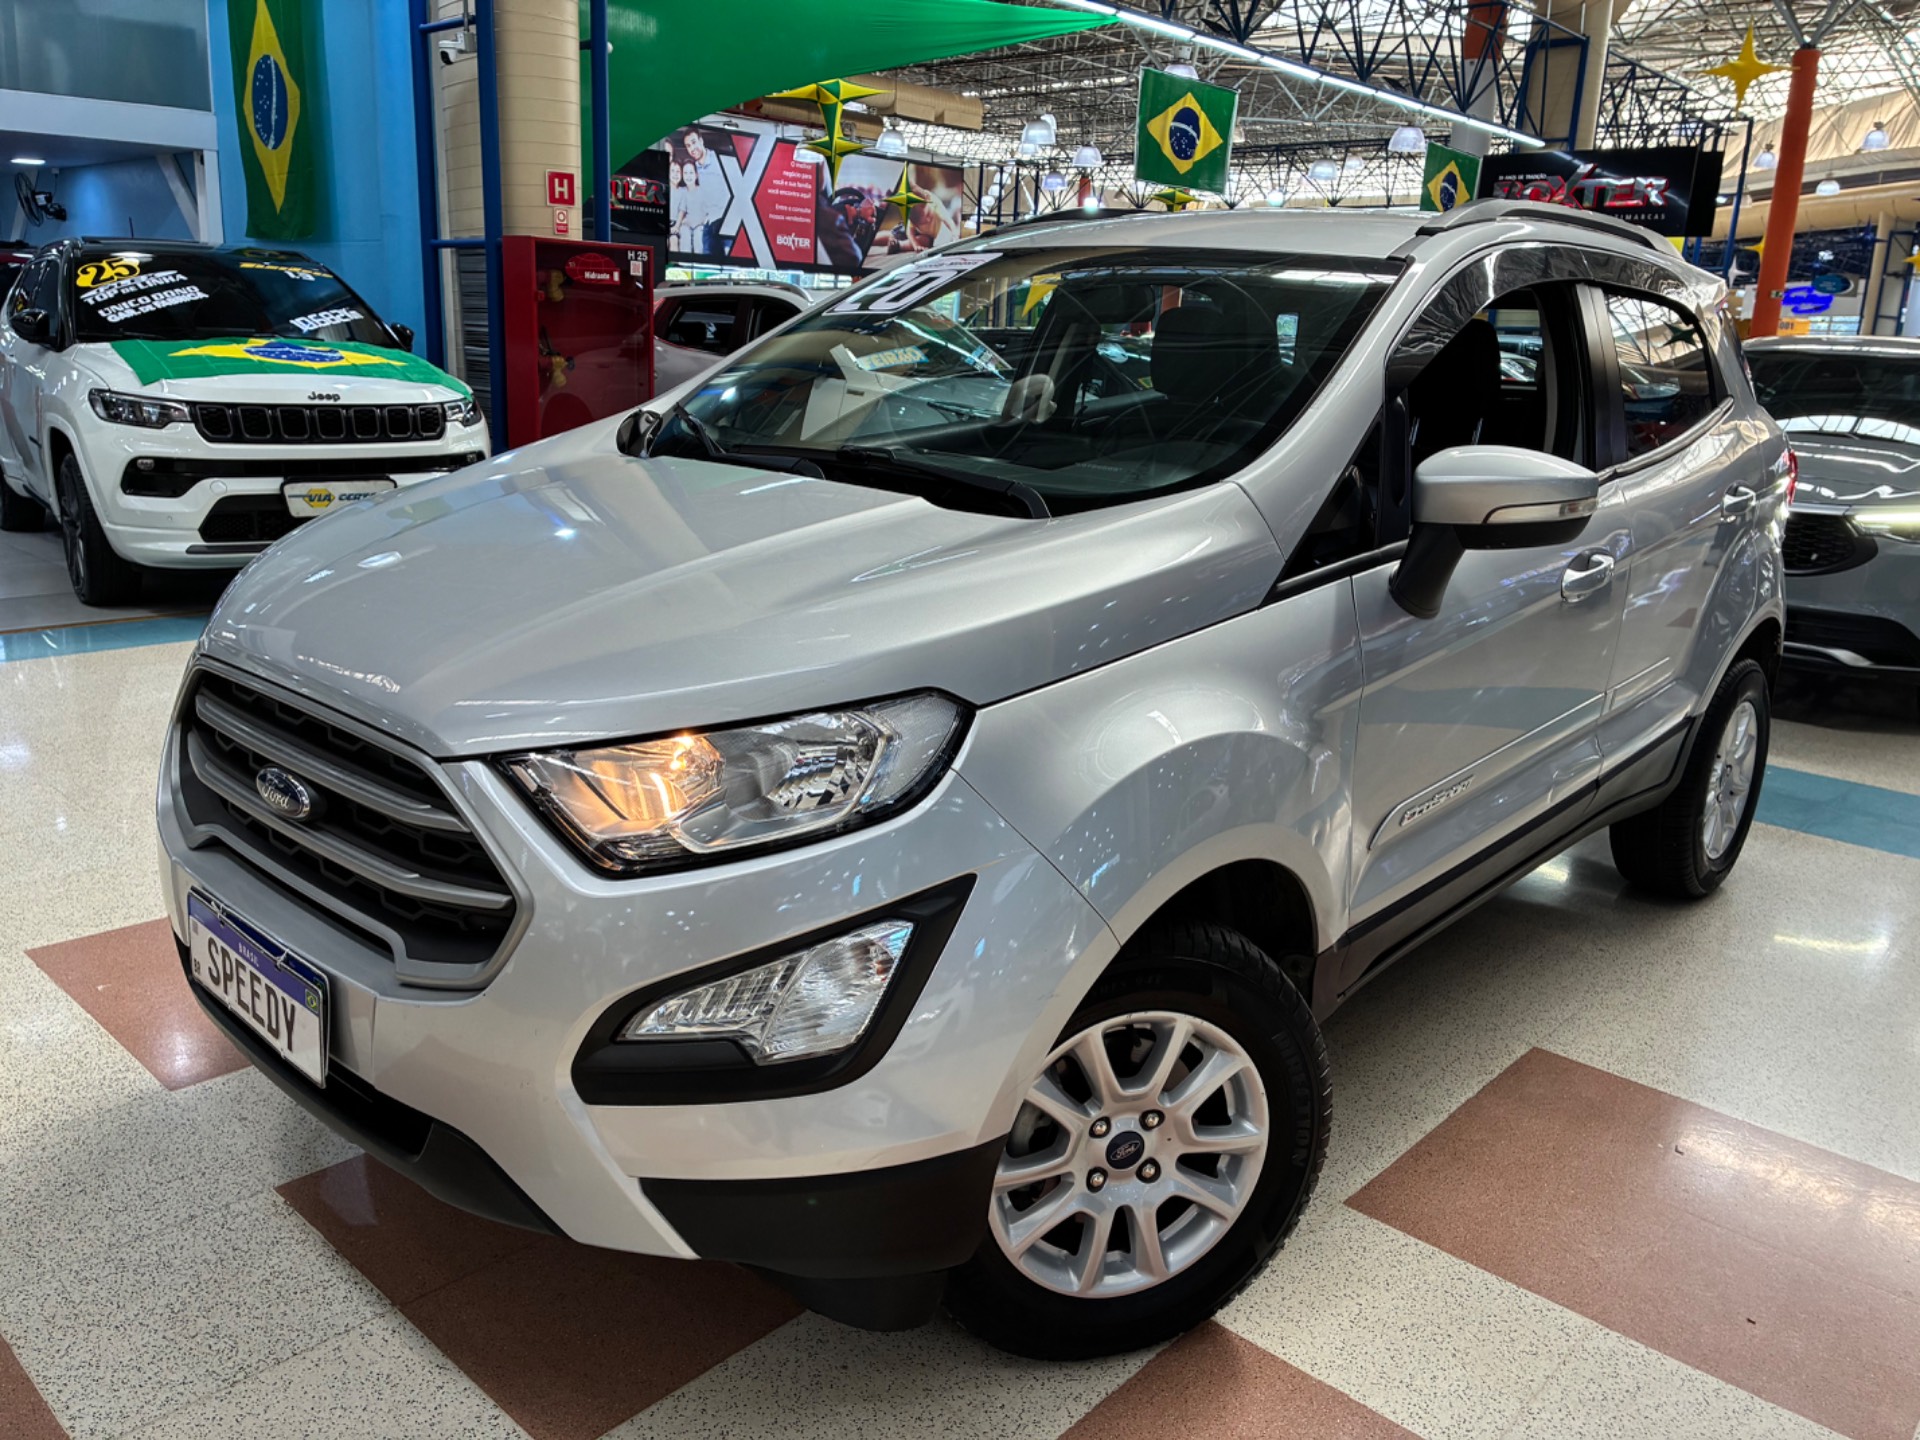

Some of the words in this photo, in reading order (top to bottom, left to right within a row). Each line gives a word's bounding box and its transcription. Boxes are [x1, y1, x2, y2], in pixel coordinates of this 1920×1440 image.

[554, 178, 569, 200] H
[1492, 163, 1669, 209] BOXTER
[776, 232, 811, 251] BOXTER
[627, 250, 636, 260] H
[637, 251, 648, 261] 25
[79, 257, 140, 287] 25
[83, 289, 119, 306] TOP
[120, 285, 138, 295] DE
[136, 273, 189, 290] LINHA
[151, 285, 200, 302] DONO
[308, 391, 341, 402] Jeep
[308, 493, 334, 502] VIA
[261, 772, 291, 809] Ford
[238, 942, 260, 968] BRASIL
[207, 937, 296, 1052] SPEEDY
[1115, 1143, 1138, 1159] Ford
